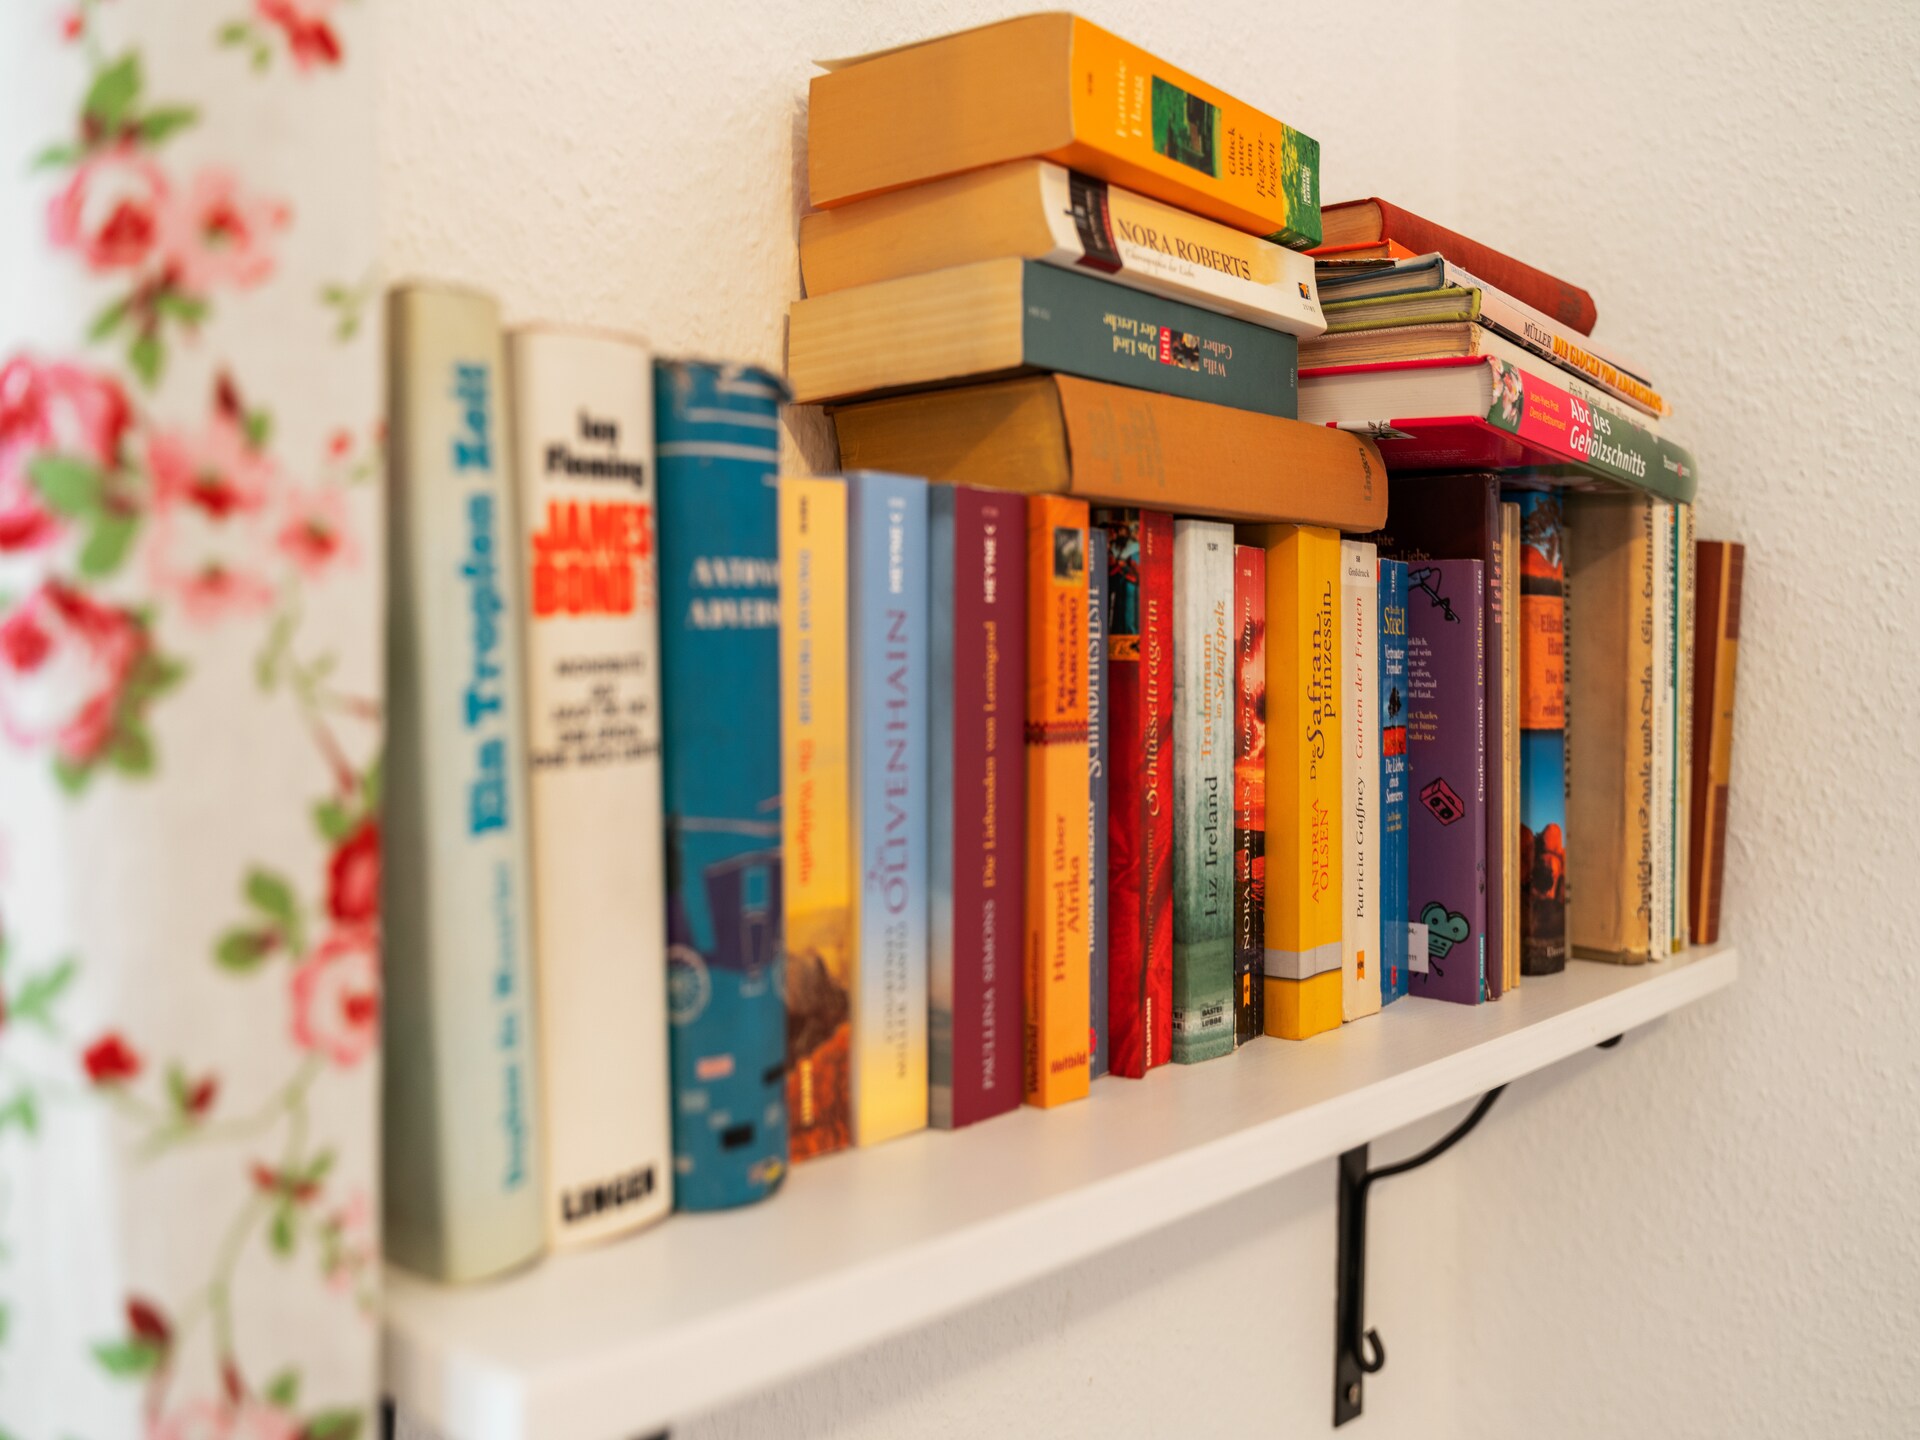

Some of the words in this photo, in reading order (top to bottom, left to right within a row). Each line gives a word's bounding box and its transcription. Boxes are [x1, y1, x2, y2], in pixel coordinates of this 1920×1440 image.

[1228, 127, 1236, 176] Glück
[1267, 142, 1278, 199] bogen
[1117, 218, 1173, 256] NORA
[1178, 234, 1251, 281] ROBERTS
[1103, 312, 1138, 335] Lerche
[1112, 335, 1137, 357] Lied
[1138, 322, 1157, 337] der
[1139, 343, 1157, 361] Das
[1203, 338, 1233, 359] Cather
[1523, 322, 1552, 349] MÜLLER
[1203, 357, 1227, 378] Willa
[1570, 398, 1591, 427] Abc
[1593, 408, 1611, 436] des
[1569, 425, 1646, 478] Gehölzschnitts
[531, 502, 653, 560] JAMES
[1214, 600, 1226, 701] Schafspelz
[1320, 580, 1336, 719] prinzessin
[1355, 597, 1363, 659] Frauen
[1384, 606, 1405, 636] Steel
[983, 620, 999, 712] Leningrad
[1201, 633, 1213, 760] Traummann
[1307, 613, 1325, 759] Safran
[985, 716, 996, 752] von
[1243, 706, 1253, 762] Hafen
[1356, 698, 1364, 759] Garten
[884, 609, 909, 915] OLIVENHAIN
[1309, 743, 1318, 781] Die
[982, 756, 997, 850] Liebenden
[1204, 775, 1218, 869] Ireland
[1356, 776, 1366, 845] Gaffney
[1053, 815, 1067, 871] über
[1243, 785, 1251, 884] ROBERTS
[1311, 799, 1320, 904] ANDREA
[1319, 808, 1330, 891] OLSEN
[982, 852, 997, 889] Die
[1067, 856, 1081, 934] Afrika
[1204, 880, 1218, 918] Liz
[1356, 849, 1364, 918] Patricia
[982, 899, 996, 983] SIMONS
[1053, 879, 1065, 983] Himmel
[1243, 888, 1251, 951] NORA
[982, 986, 996, 1091] PAULLINA
